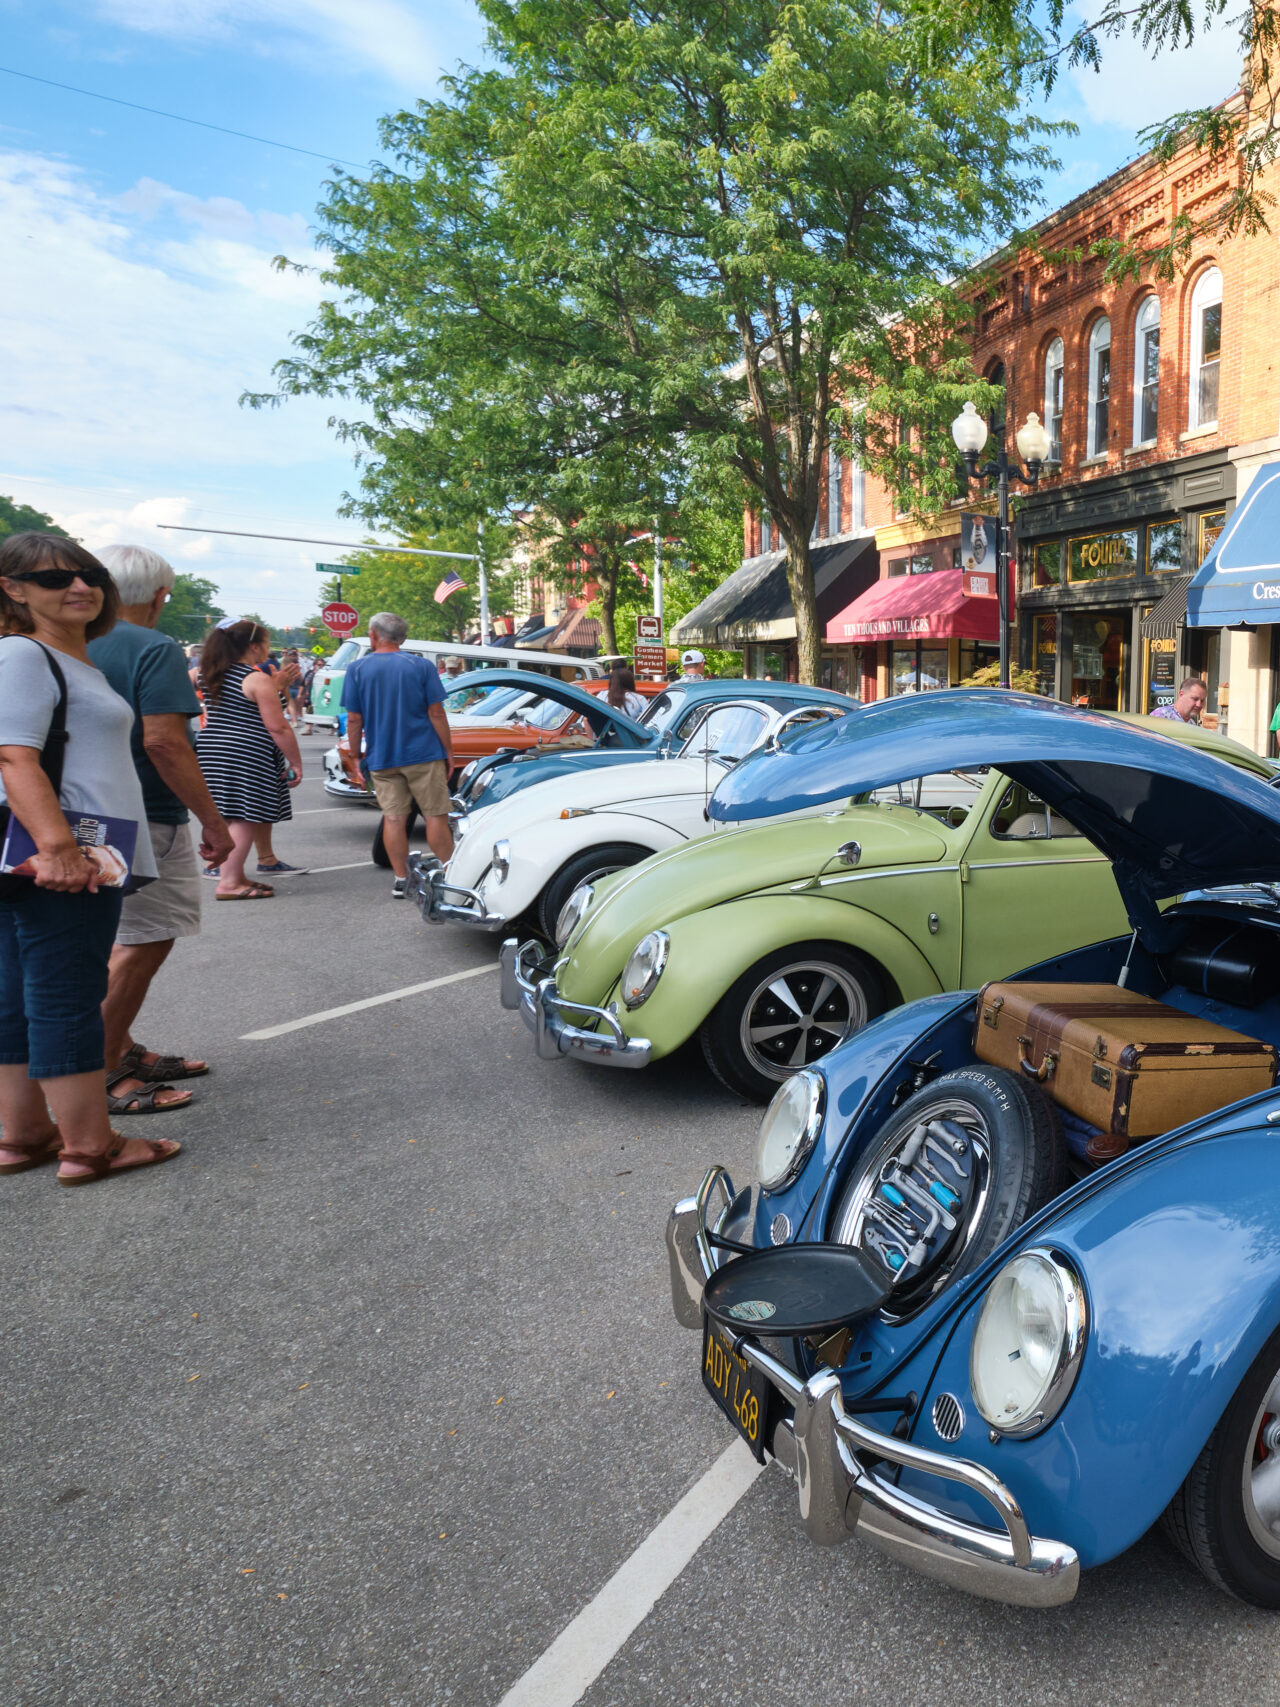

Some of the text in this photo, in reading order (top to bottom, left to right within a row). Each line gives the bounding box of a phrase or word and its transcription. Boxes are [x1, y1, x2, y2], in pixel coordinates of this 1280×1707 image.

[1081, 539, 1127, 568] FOUND
[324, 611, 356, 624] STOP
[844, 619, 929, 636] TEN THOUSAND VILLAGES
[79, 818, 98, 844] GLORY
[959, 1071, 986, 1082] SPEED
[984, 1079, 997, 1089] 50
[706, 1334, 732, 1398] ADY
